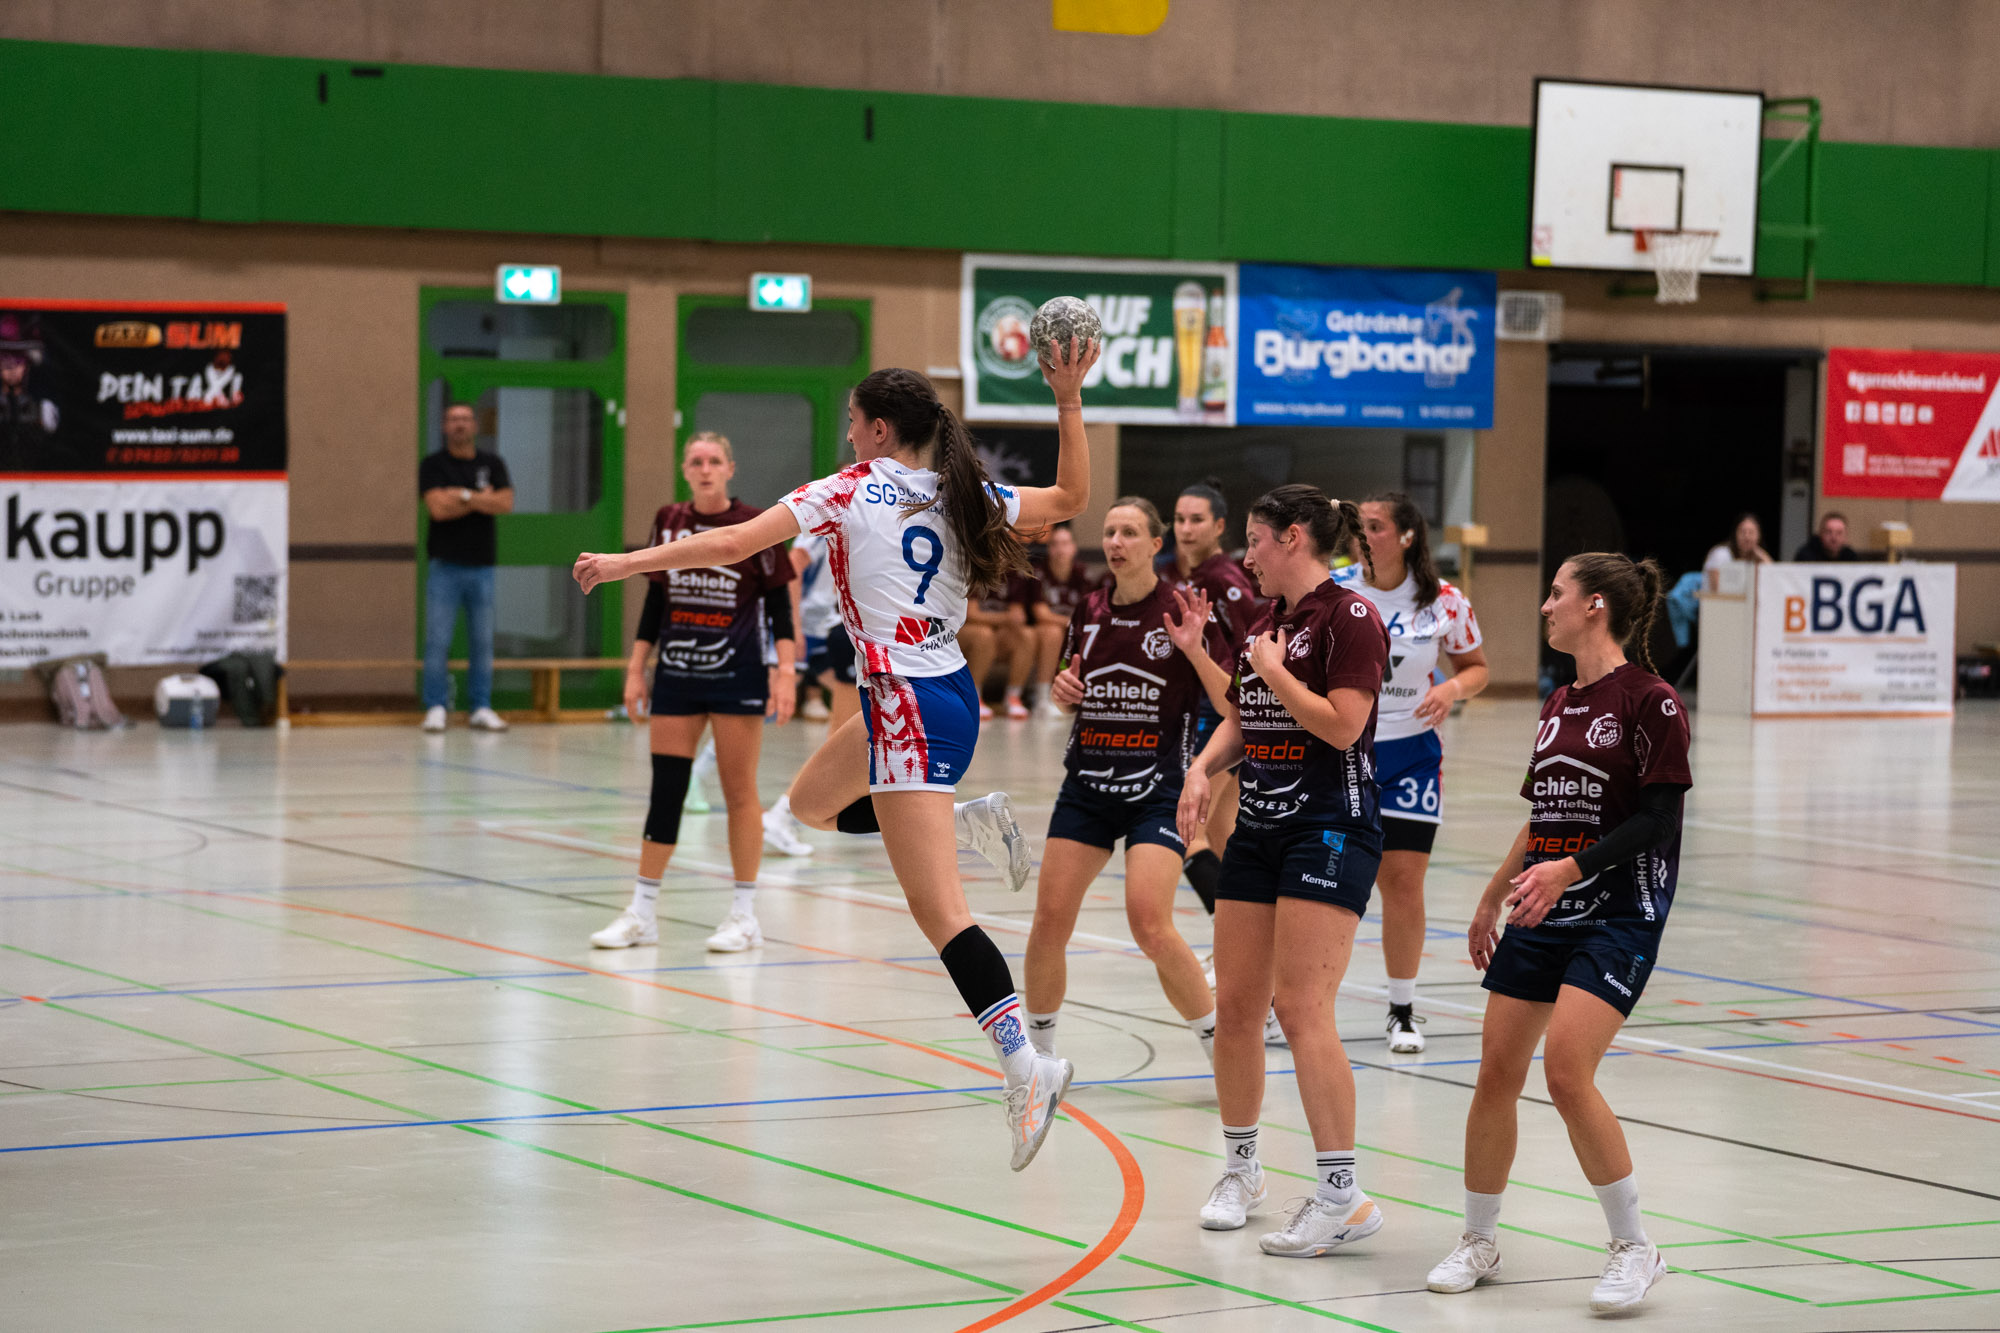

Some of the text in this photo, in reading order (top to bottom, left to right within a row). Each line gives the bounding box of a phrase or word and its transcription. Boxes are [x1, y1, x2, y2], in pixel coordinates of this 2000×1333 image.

[866, 483, 897, 506] SG
[6, 494, 226, 576] kaupp
[902, 525, 944, 605] 9
[34, 571, 137, 599] Gruppe
[670, 572, 737, 590] Schiele
[1111, 617, 1141, 628] Kempa
[1387, 611, 1405, 636] 6
[1083, 624, 1100, 660] 7
[1084, 681, 1160, 700] Schiele
[1239, 685, 1282, 705] Schie
[1120, 702, 1159, 711] Tiefbau
[1265, 709, 1292, 717] Tiefb
[1563, 706, 1590, 715] Kempa
[1396, 777, 1438, 812] 36
[1533, 776, 1603, 798] chiele
[1558, 800, 1601, 811] Tiefbau
[1302, 873, 1338, 889] Kempa
[1604, 972, 1632, 998] Kempa
[1002, 1034, 1026, 1054] SGDS
